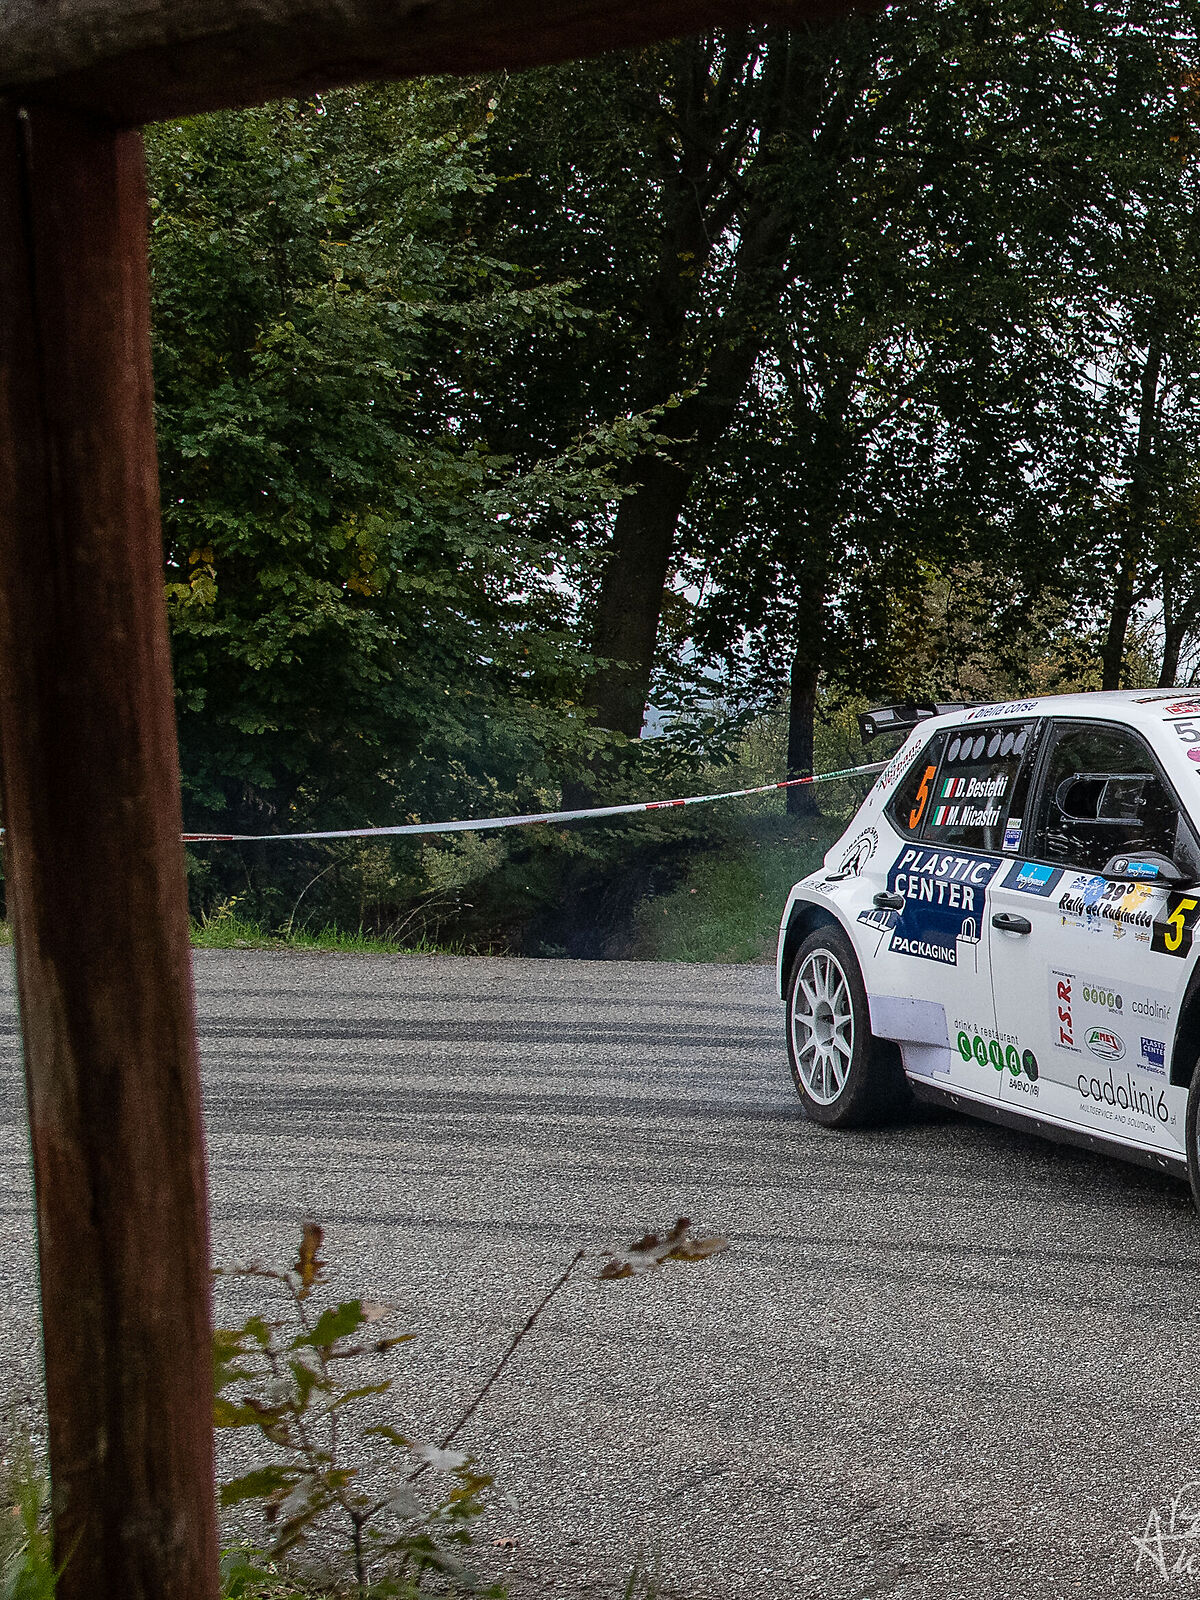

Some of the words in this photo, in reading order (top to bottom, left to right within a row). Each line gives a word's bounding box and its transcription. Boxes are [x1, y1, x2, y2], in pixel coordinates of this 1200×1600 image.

[974, 705, 1001, 718] biella
[1004, 701, 1039, 714] corse
[909, 766, 937, 829] 5
[954, 778, 966, 798] D.
[966, 776, 1009, 798] Bestetti
[945, 806, 960, 826] M.
[960, 805, 1002, 826] Nicastri
[898, 849, 994, 884] PLASTIC
[894, 874, 974, 912] CENTER
[1058, 892, 1086, 916] Rally
[1086, 900, 1104, 917] del
[1102, 904, 1153, 928] Rubinetto
[1163, 898, 1199, 952] 5
[891, 936, 956, 962] PACKAGING
[1057, 978, 1074, 1046] T.S.R.
[954, 1018, 972, 1032] drink
[974, 1023, 979, 1034] &
[980, 1026, 1019, 1046] restaurant
[1008, 1078, 1030, 1093] BAVENO
[1078, 1068, 1169, 1122] cadolini6
[1080, 1103, 1114, 1120] MULTISERVICE
[1114, 1114, 1126, 1124] AND
[1127, 1118, 1156, 1134] SOLUTIONS
